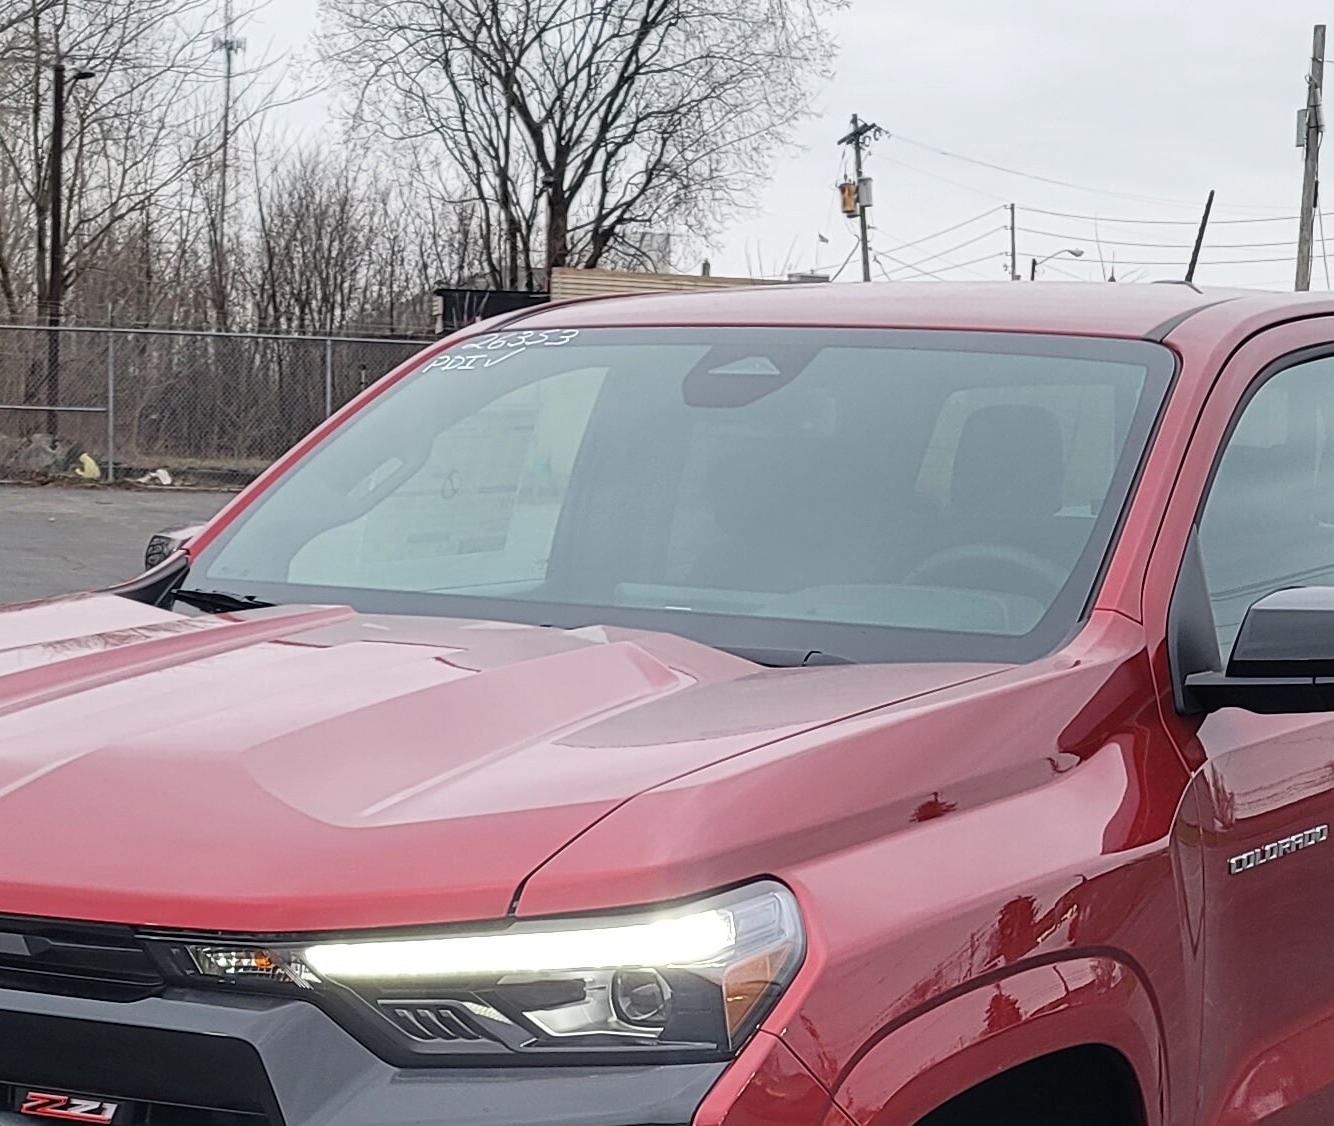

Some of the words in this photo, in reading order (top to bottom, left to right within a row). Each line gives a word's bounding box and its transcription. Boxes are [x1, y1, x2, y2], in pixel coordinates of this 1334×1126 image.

[462, 329, 579, 349] 26353
[1229, 824, 1329, 875] COLORADO
[21, 1091, 118, 1124] Z71
